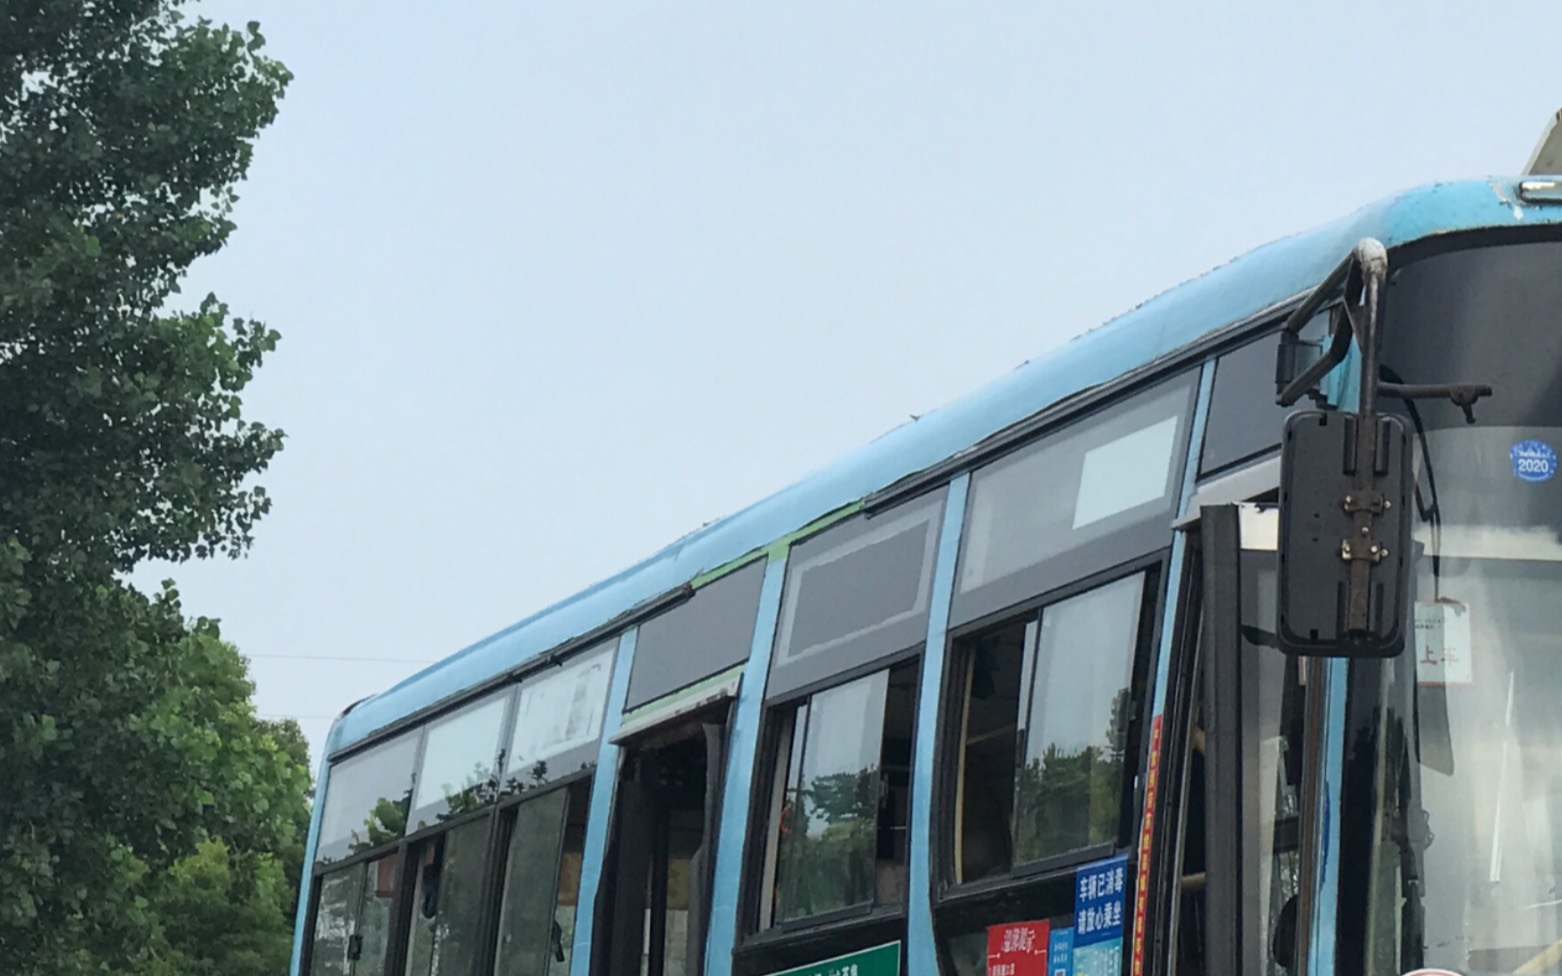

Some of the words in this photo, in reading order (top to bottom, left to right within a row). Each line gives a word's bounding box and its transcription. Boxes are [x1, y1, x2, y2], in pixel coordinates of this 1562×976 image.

[1518, 458, 1549, 473] 2020
[1079, 867, 1124, 902] 车辆已消毒
[1077, 900, 1121, 935] 请放心乘坐
